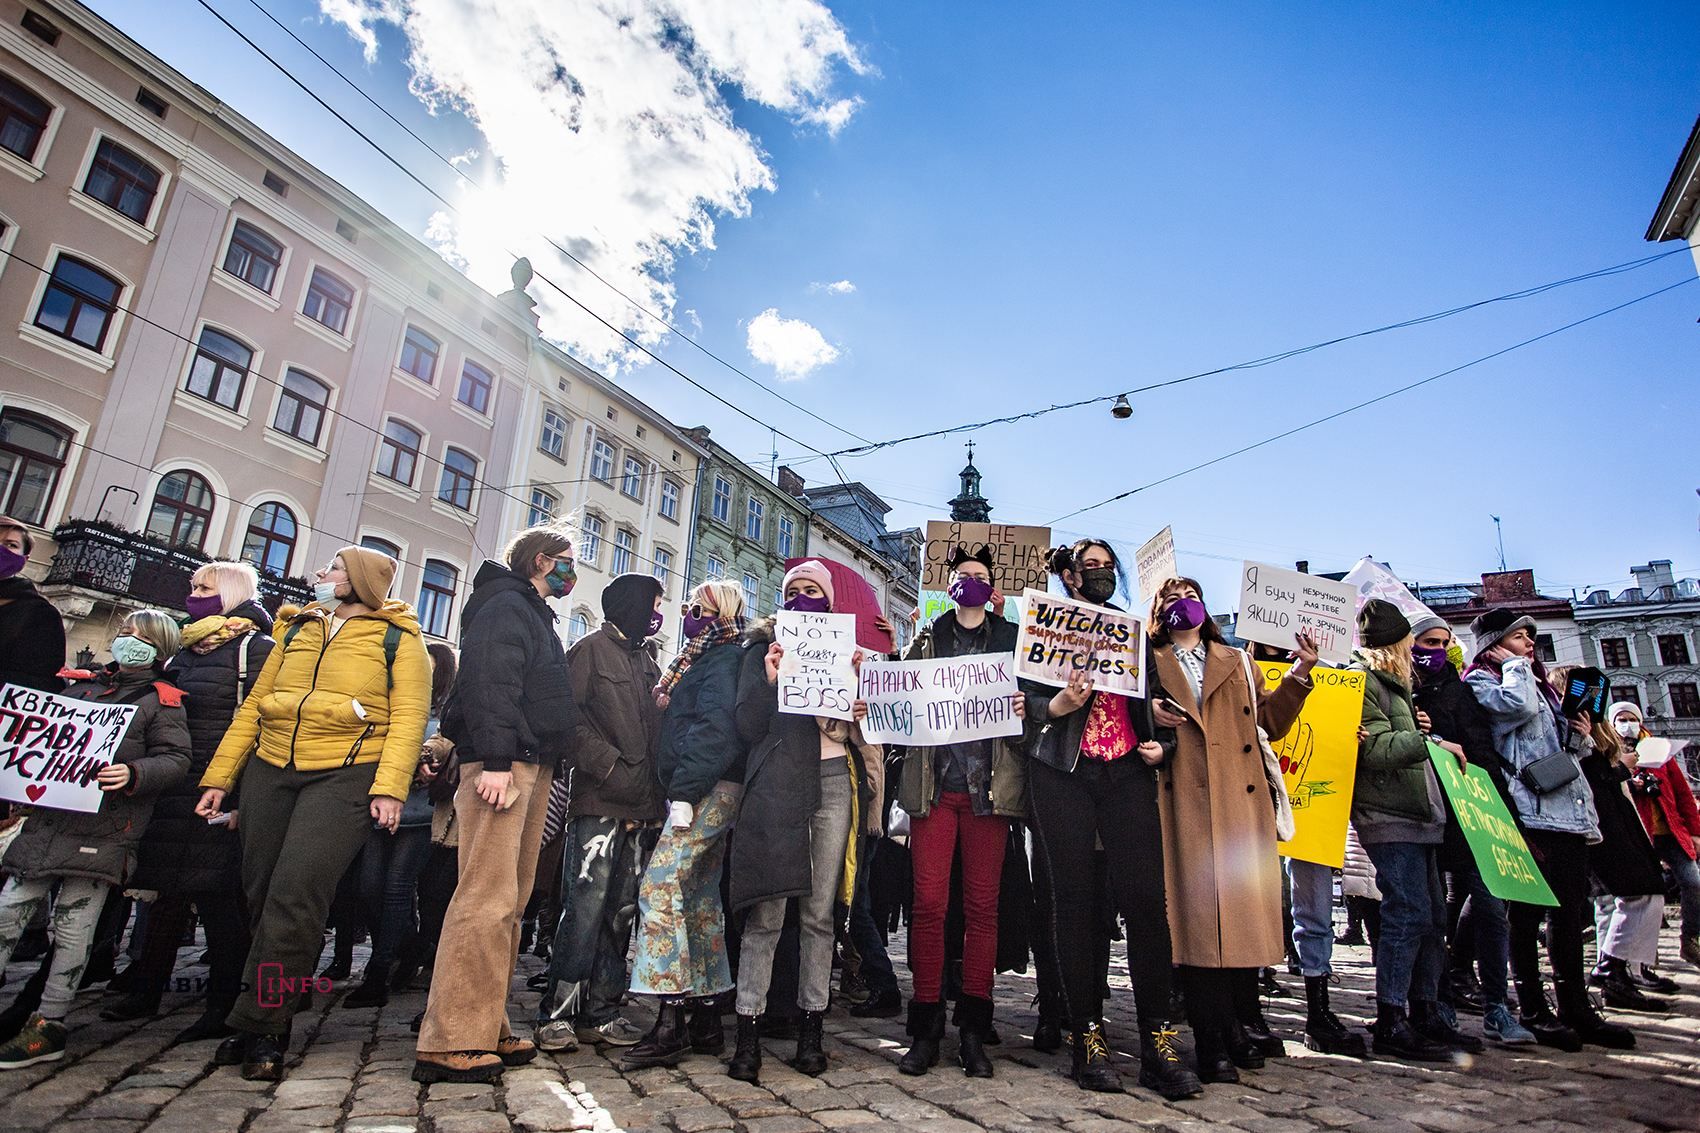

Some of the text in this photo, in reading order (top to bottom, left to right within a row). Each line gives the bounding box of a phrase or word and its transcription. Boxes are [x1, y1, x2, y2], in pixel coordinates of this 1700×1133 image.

[949, 522, 1015, 543] Я НЕ
[1246, 566, 1258, 593] Я
[1302, 586, 1346, 604] НЕЗРУЧНОЮ
[1247, 603, 1290, 628] ЯКЩО
[1321, 604, 1340, 615] ТЕБЕ
[782, 625, 844, 640] NOT
[1035, 603, 1129, 643] Witches
[1296, 613, 1347, 636] ТАК ЗРУЧНО
[1026, 625, 1129, 656] supporting other
[785, 676, 845, 686] THE
[861, 669, 880, 698] НА
[882, 670, 923, 694] РАНОК
[783, 685, 851, 713] BOSS
[0, 707, 94, 756] ПРАВА
